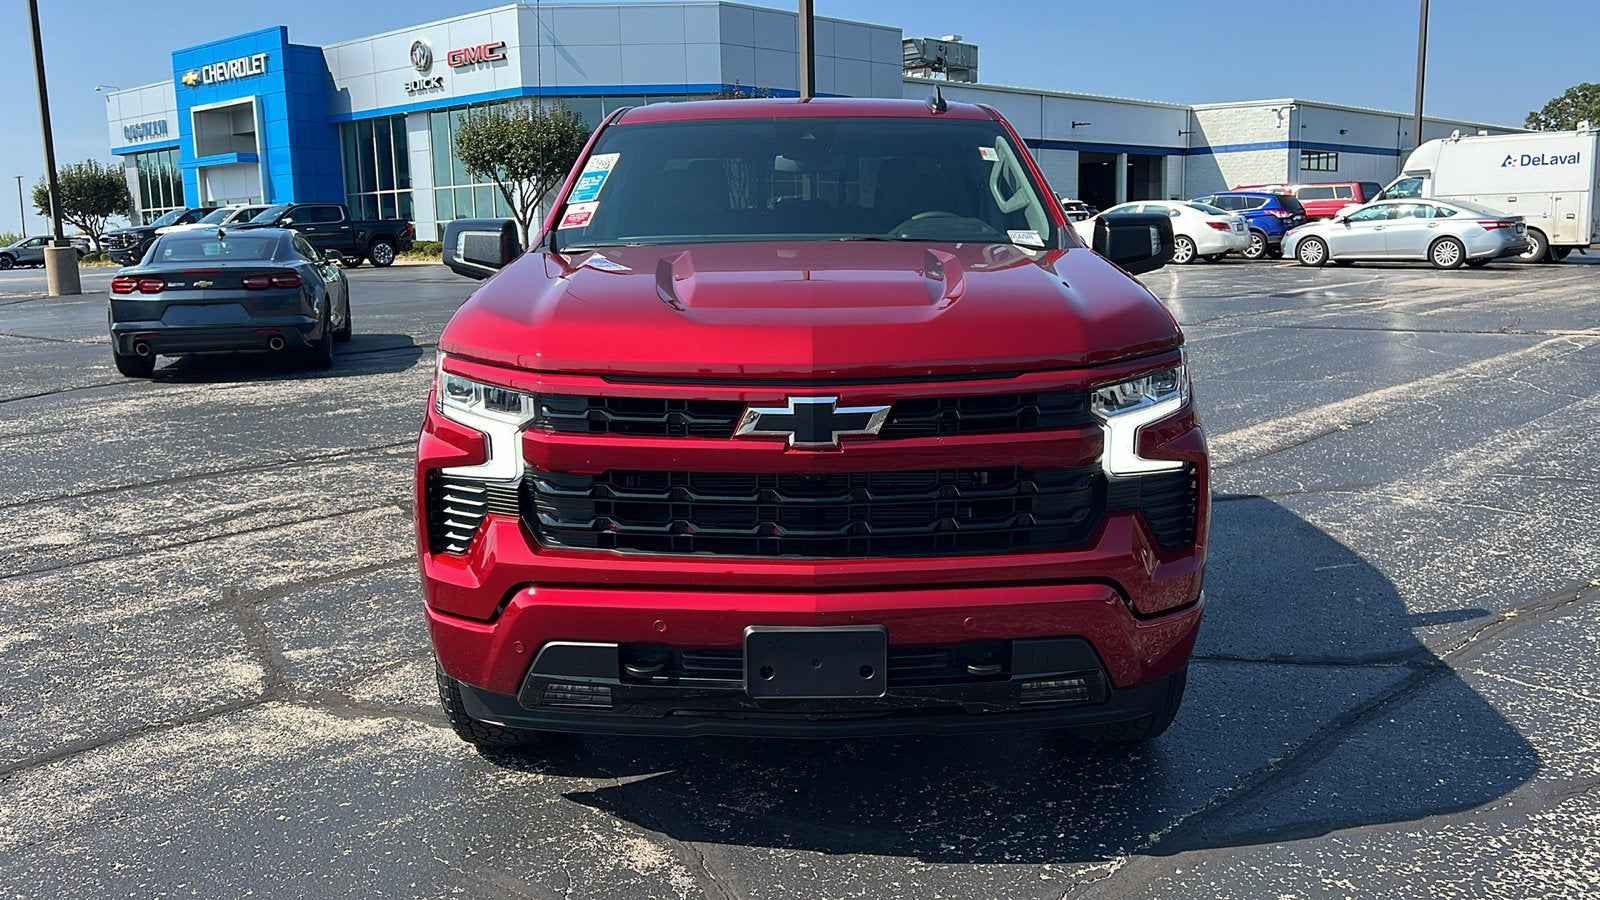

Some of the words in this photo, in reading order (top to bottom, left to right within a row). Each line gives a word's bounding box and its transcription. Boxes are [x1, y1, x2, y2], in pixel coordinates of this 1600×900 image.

[447, 42, 503, 67] GMC
[202, 52, 267, 84] CHEVROLET
[404, 76, 444, 92] BUICK
[1520, 152, 1580, 166] DeLaval
